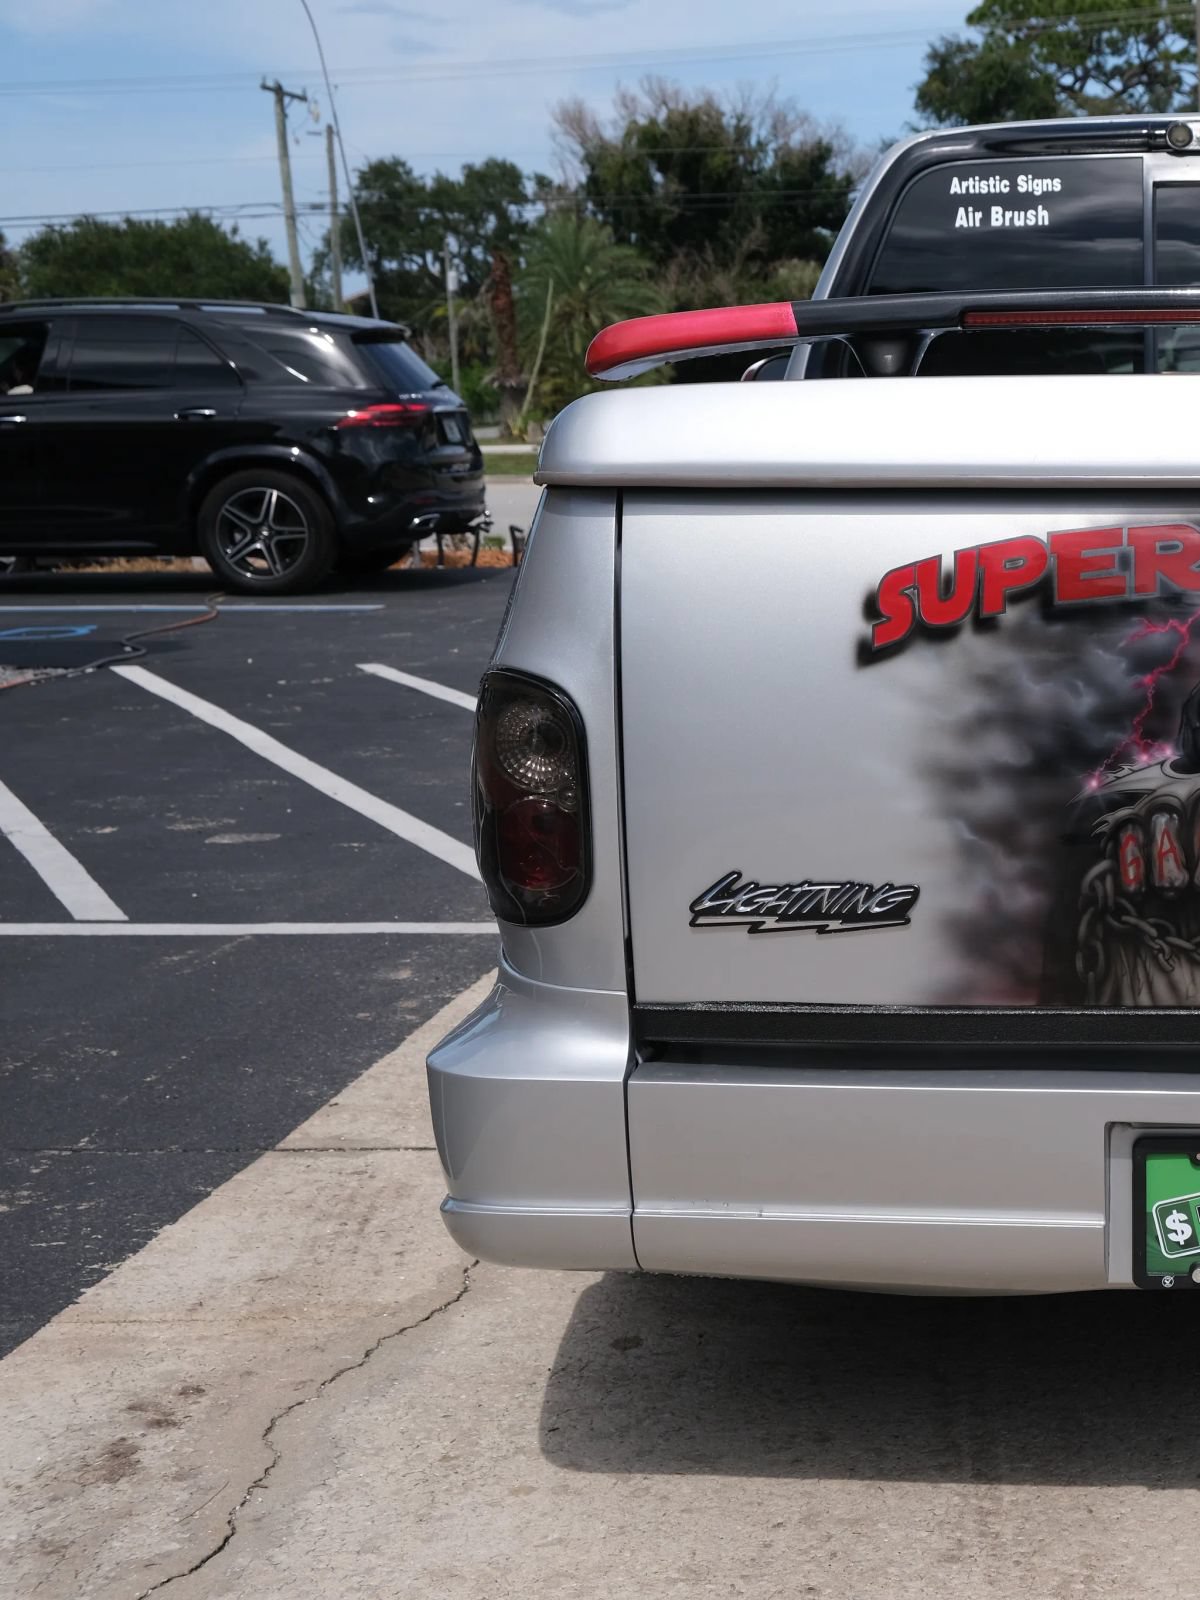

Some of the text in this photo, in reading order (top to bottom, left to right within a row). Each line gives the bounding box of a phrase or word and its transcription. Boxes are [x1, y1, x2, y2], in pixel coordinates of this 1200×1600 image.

[949, 174, 1062, 196] Artistic Signs
[954, 204, 1050, 228] Air Brush
[691, 871, 919, 917] LIGHTNING
